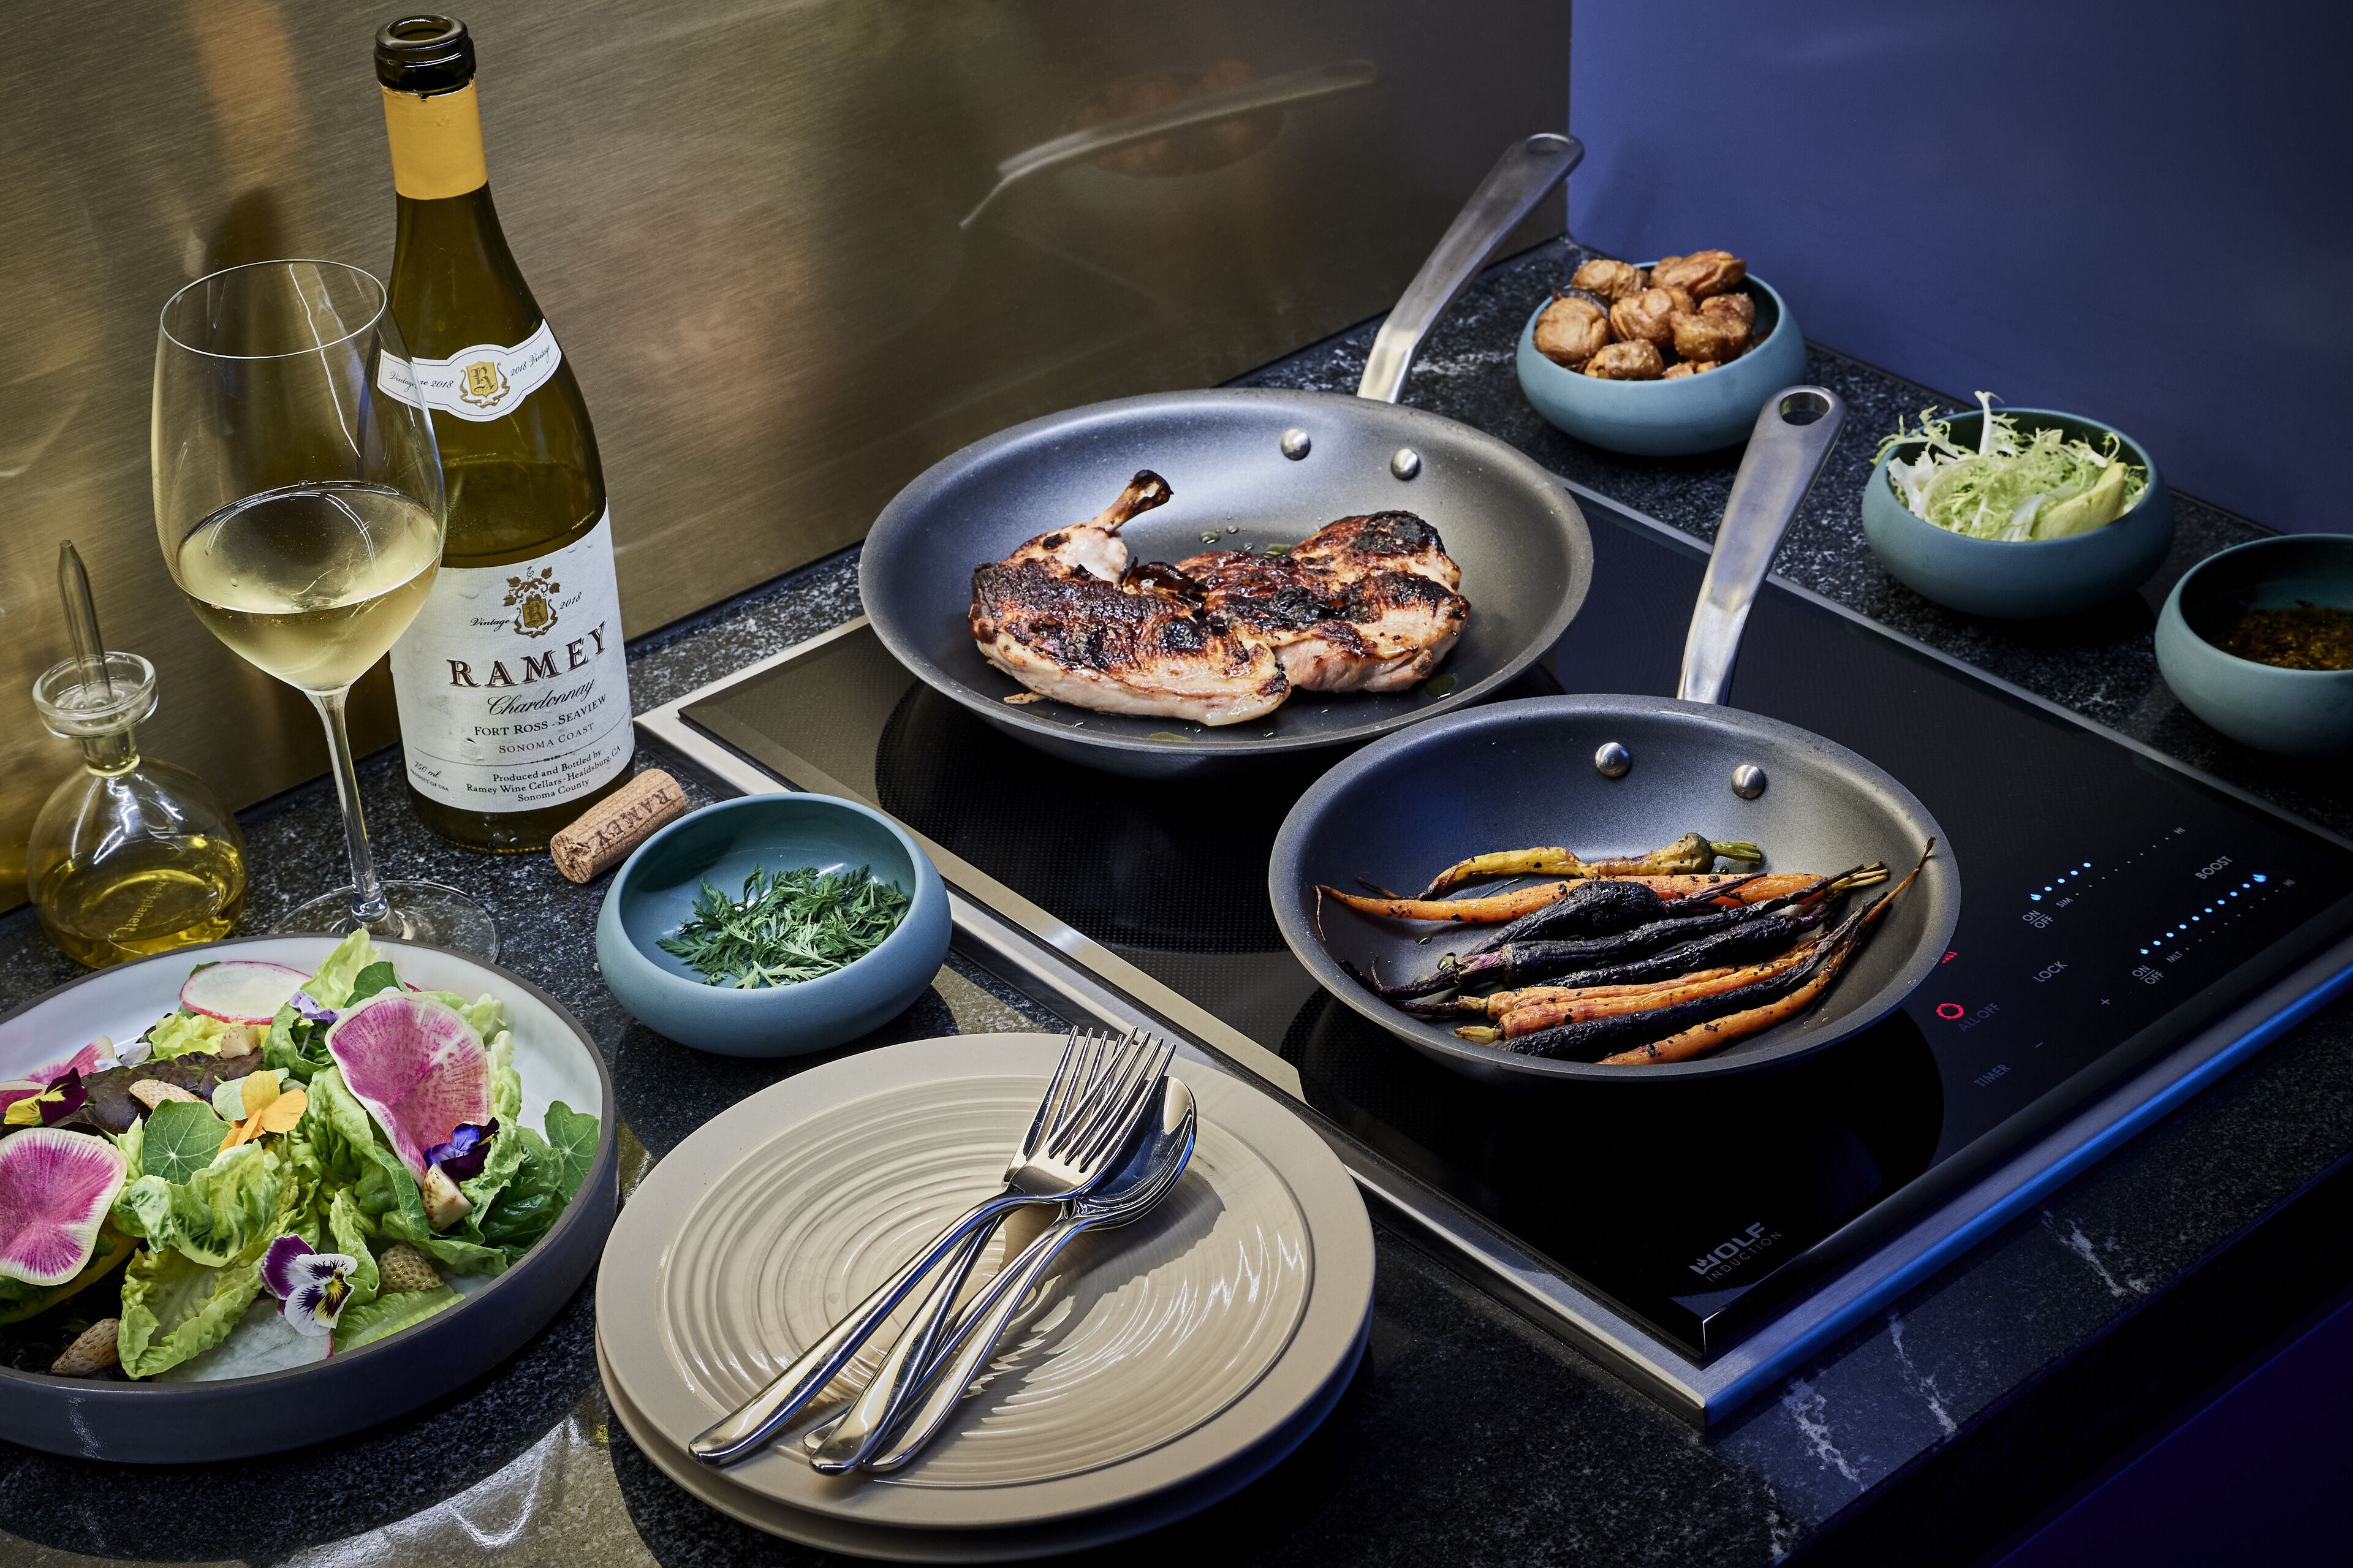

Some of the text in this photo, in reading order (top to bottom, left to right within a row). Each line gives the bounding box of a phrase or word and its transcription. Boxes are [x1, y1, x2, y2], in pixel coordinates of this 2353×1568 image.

[510, 362, 526, 376] 2018
[559, 592, 582, 610] 2018
[470, 617, 510, 632] Vintage
[446, 620, 608, 687] RAMEY
[488, 679, 594, 715] Chardonnay
[474, 726, 509, 736] FORT
[513, 721, 548, 734] ROSS
[558, 694, 606, 725] SEAVIEW
[499, 722, 594, 754] SONOMA COAST
[415, 760, 428, 773] 750
[466, 784, 497, 795] Ramey
[500, 784, 526, 793] Wine
[612, 745, 621, 757] CA
[493, 750, 602, 782] Produced and Bottled by
[518, 779, 589, 802] Sonoma County
[594, 787, 671, 856] RAMEY
[2173, 827, 2186, 835] HI
[2195, 855, 2233, 879] BOOST
[2283, 879, 2295, 887] HI
[2056, 897, 2074, 908] SIM
[2022, 909, 2041, 922] ON
[2034, 915, 2054, 929] OFF
[2166, 950, 2184, 963] MLT
[2033, 960, 2068, 983] LOCK
[2132, 964, 2151, 977] ON
[2145, 971, 2164, 985] OFF
[1957, 1002, 2000, 1032] ALL OFF
[1974, 1062, 2011, 1088] TIMER
[1689, 1222, 1765, 1274] WOLF
[1705, 1231, 1782, 1282] INDUCTION
